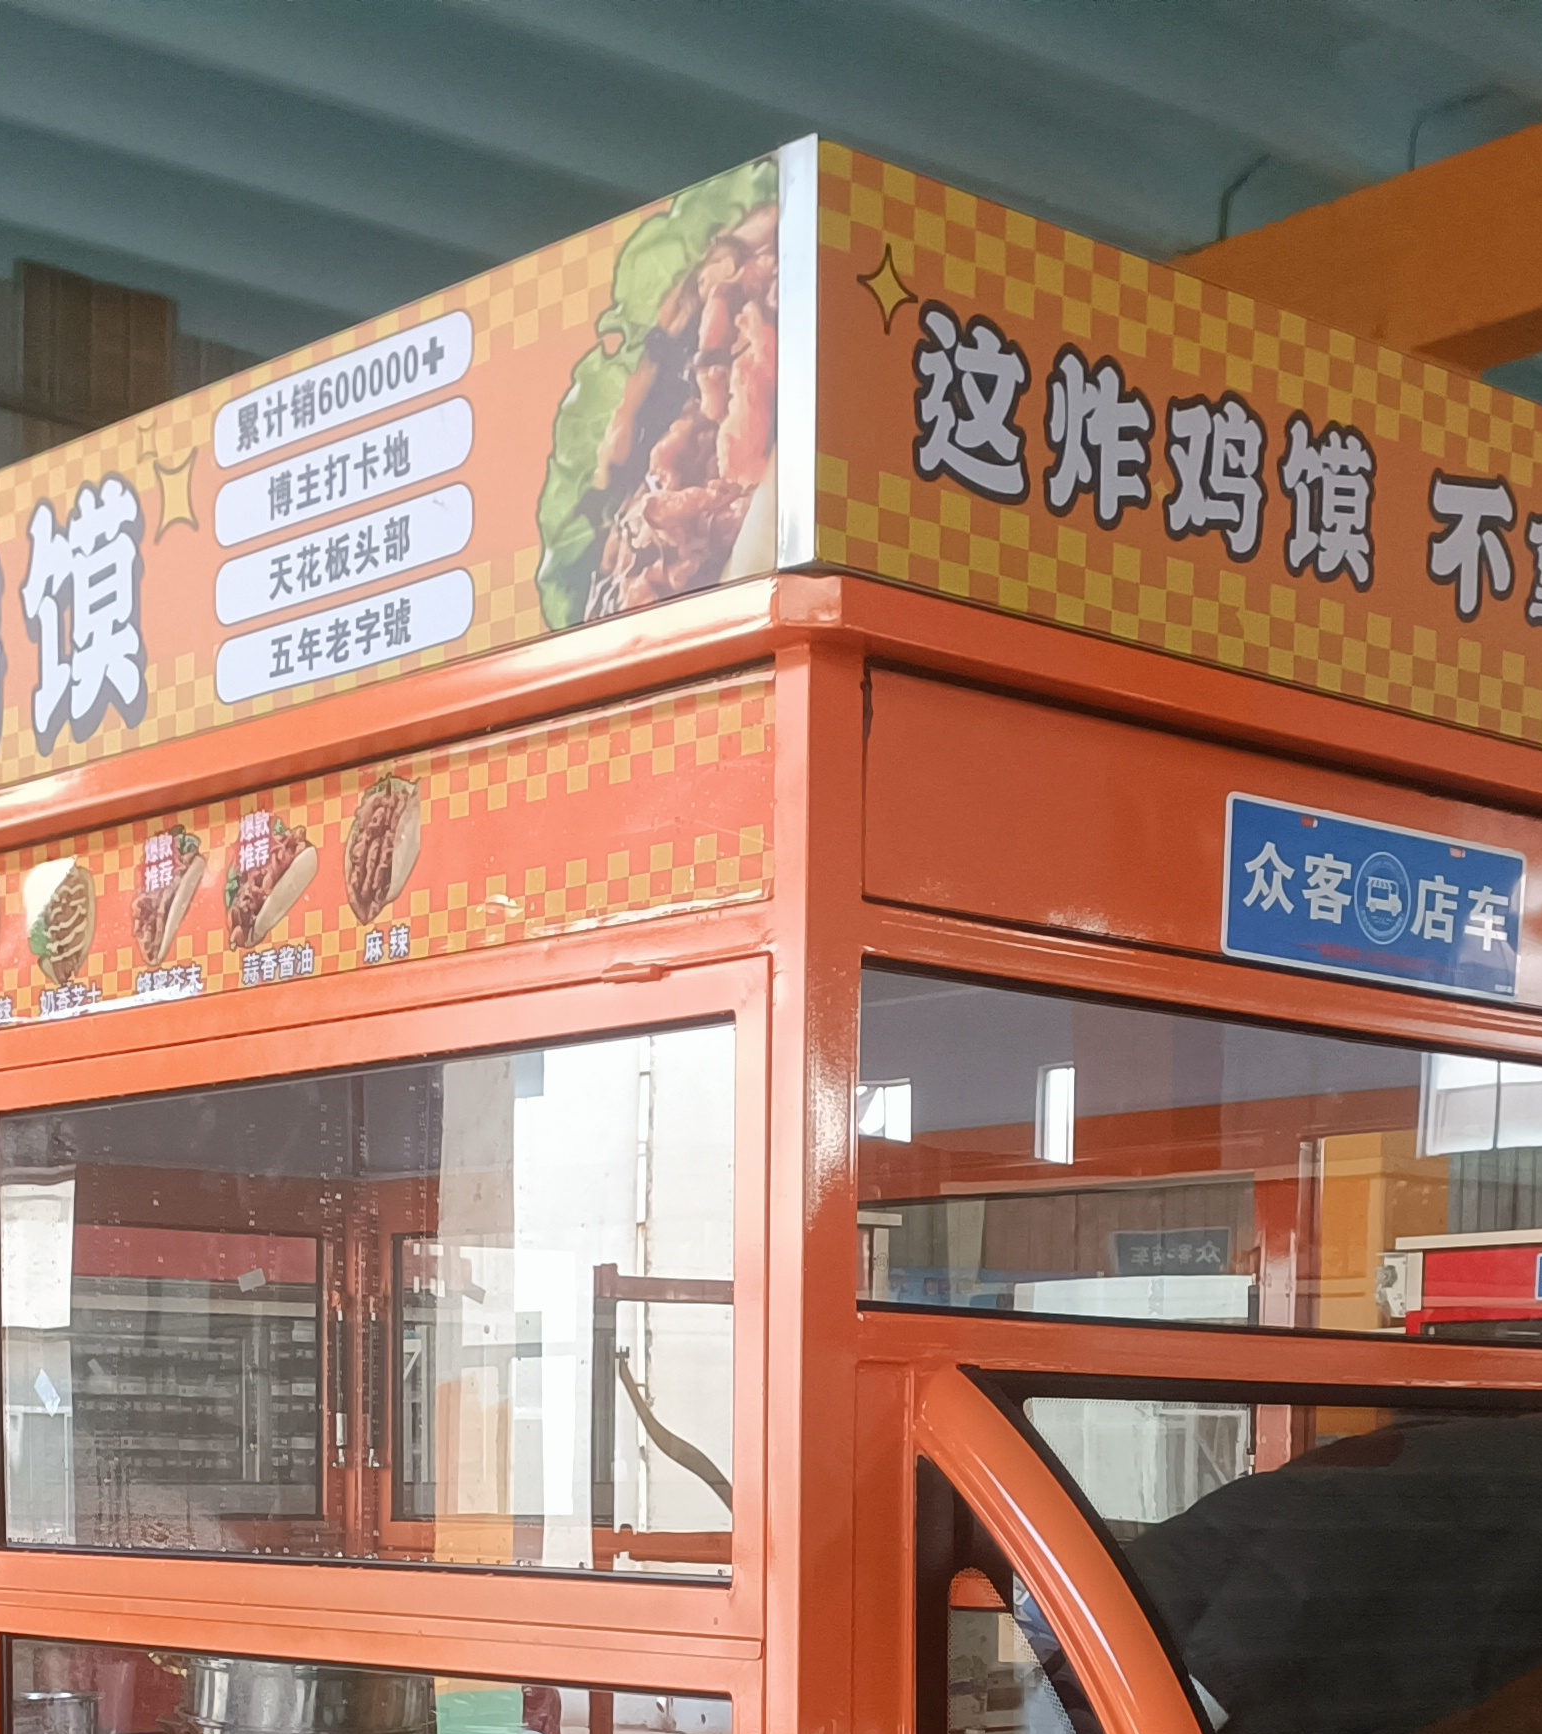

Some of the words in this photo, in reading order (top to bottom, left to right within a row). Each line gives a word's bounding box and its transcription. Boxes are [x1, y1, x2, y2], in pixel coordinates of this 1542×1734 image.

[236, 338, 445, 452] 累计销600000+
[268, 430, 410, 521] 博主打卡地
[918, 310, 1373, 583] 这炸鸡馍
[269, 516, 410, 602] 天花板头部
[145, 862, 174, 892] 推荐
[239, 840, 270, 872] 推荐
[1243, 841, 1352, 924] 众客
[1410, 875, 1509, 951] 店车
[243, 944, 314, 984] 蒜香酱油
[364, 926, 409, 962] 麻辣
